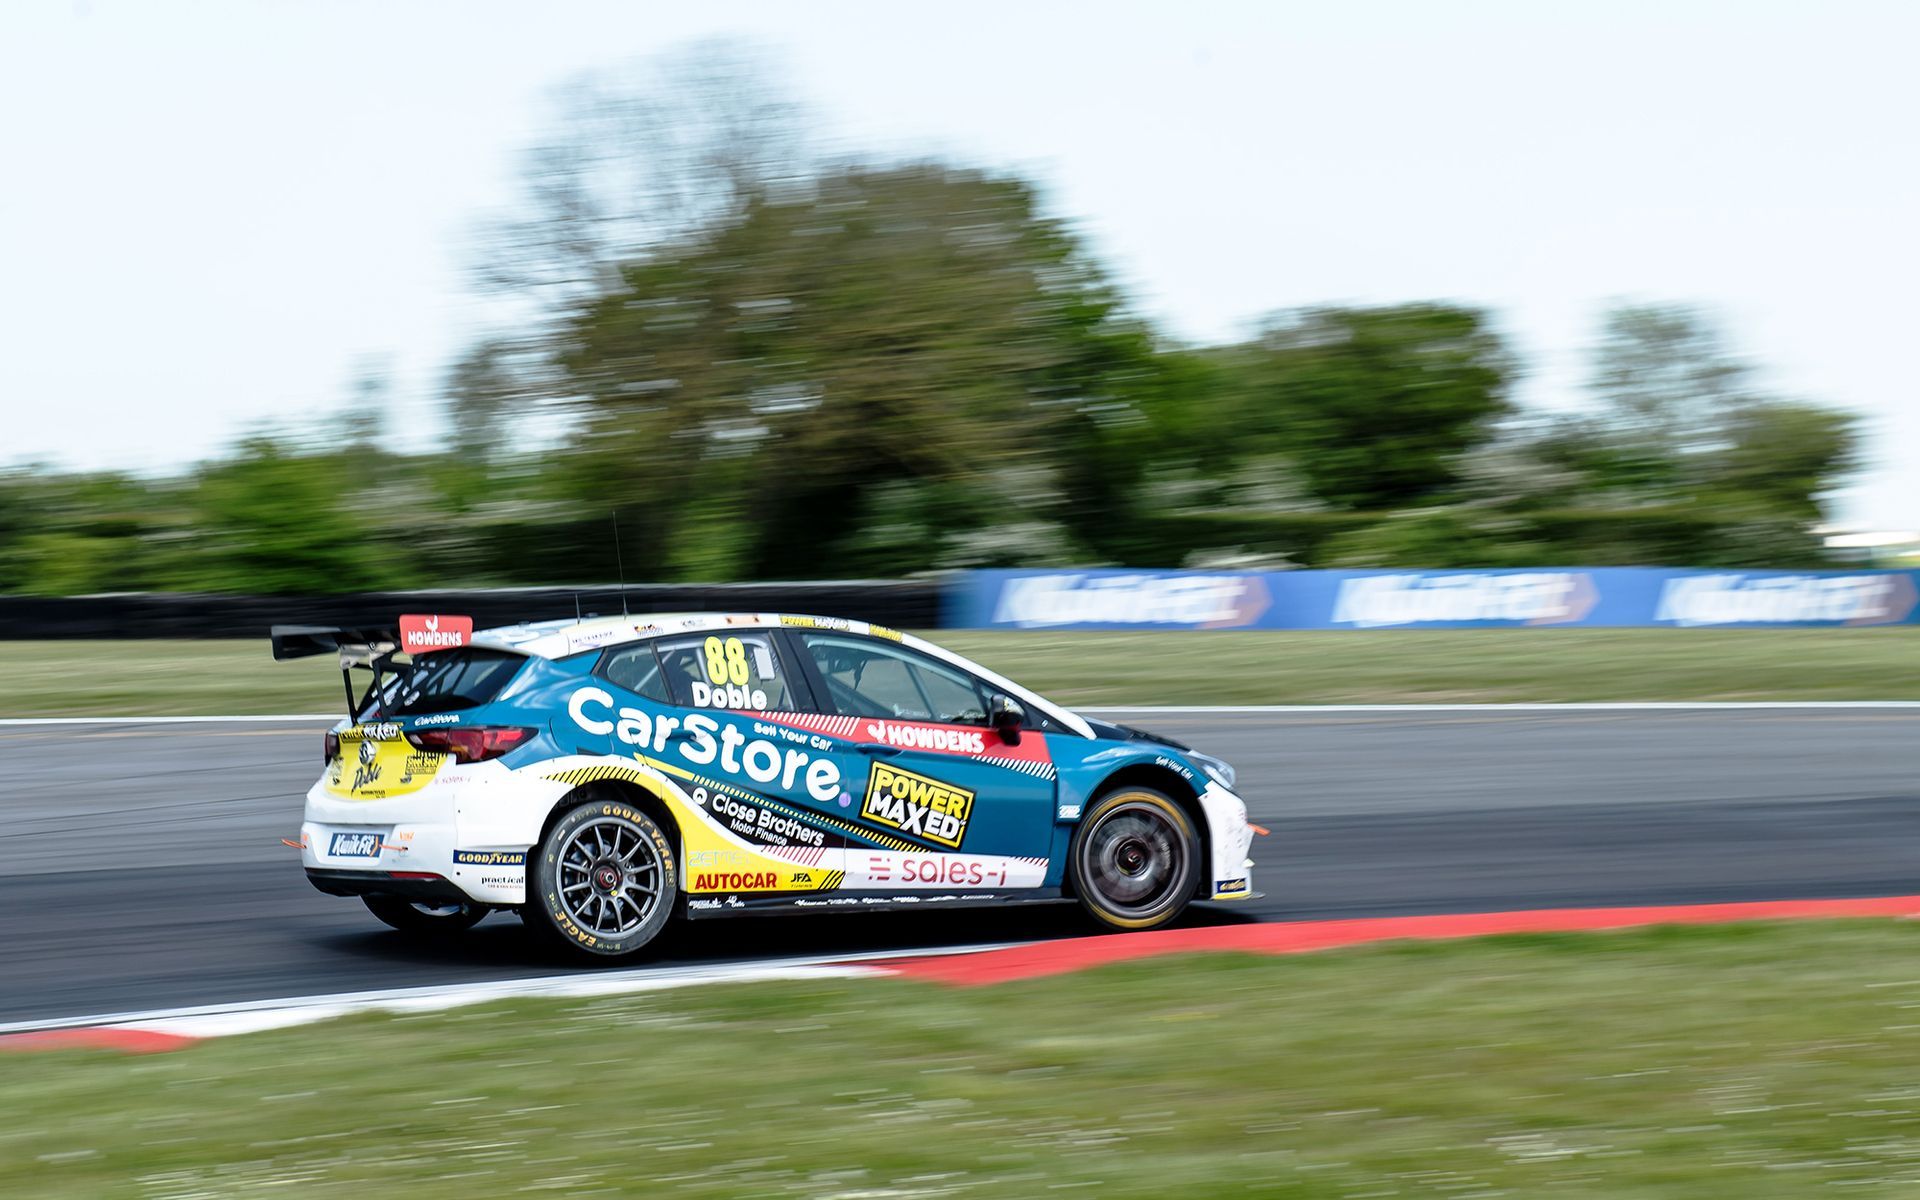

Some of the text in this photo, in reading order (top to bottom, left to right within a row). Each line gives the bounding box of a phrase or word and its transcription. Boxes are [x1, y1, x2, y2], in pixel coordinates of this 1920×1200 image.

[408, 631, 462, 647] HOWDENS
[704, 636, 749, 685] 88
[691, 681, 768, 711] Doble
[754, 722, 777, 737] Sell
[779, 727, 808, 745] Your
[887, 724, 985, 754] HOWDENS
[875, 769, 966, 819] POWER
[712, 792, 825, 847] Close Brothers
[730, 818, 788, 847] Motor Finance
[481, 875, 524, 884] practical
[695, 873, 777, 890] AUTOCAR
[791, 872, 812, 883] JFA
[901, 856, 1006, 886] sales-i
[554, 911, 597, 947] EAGLE
